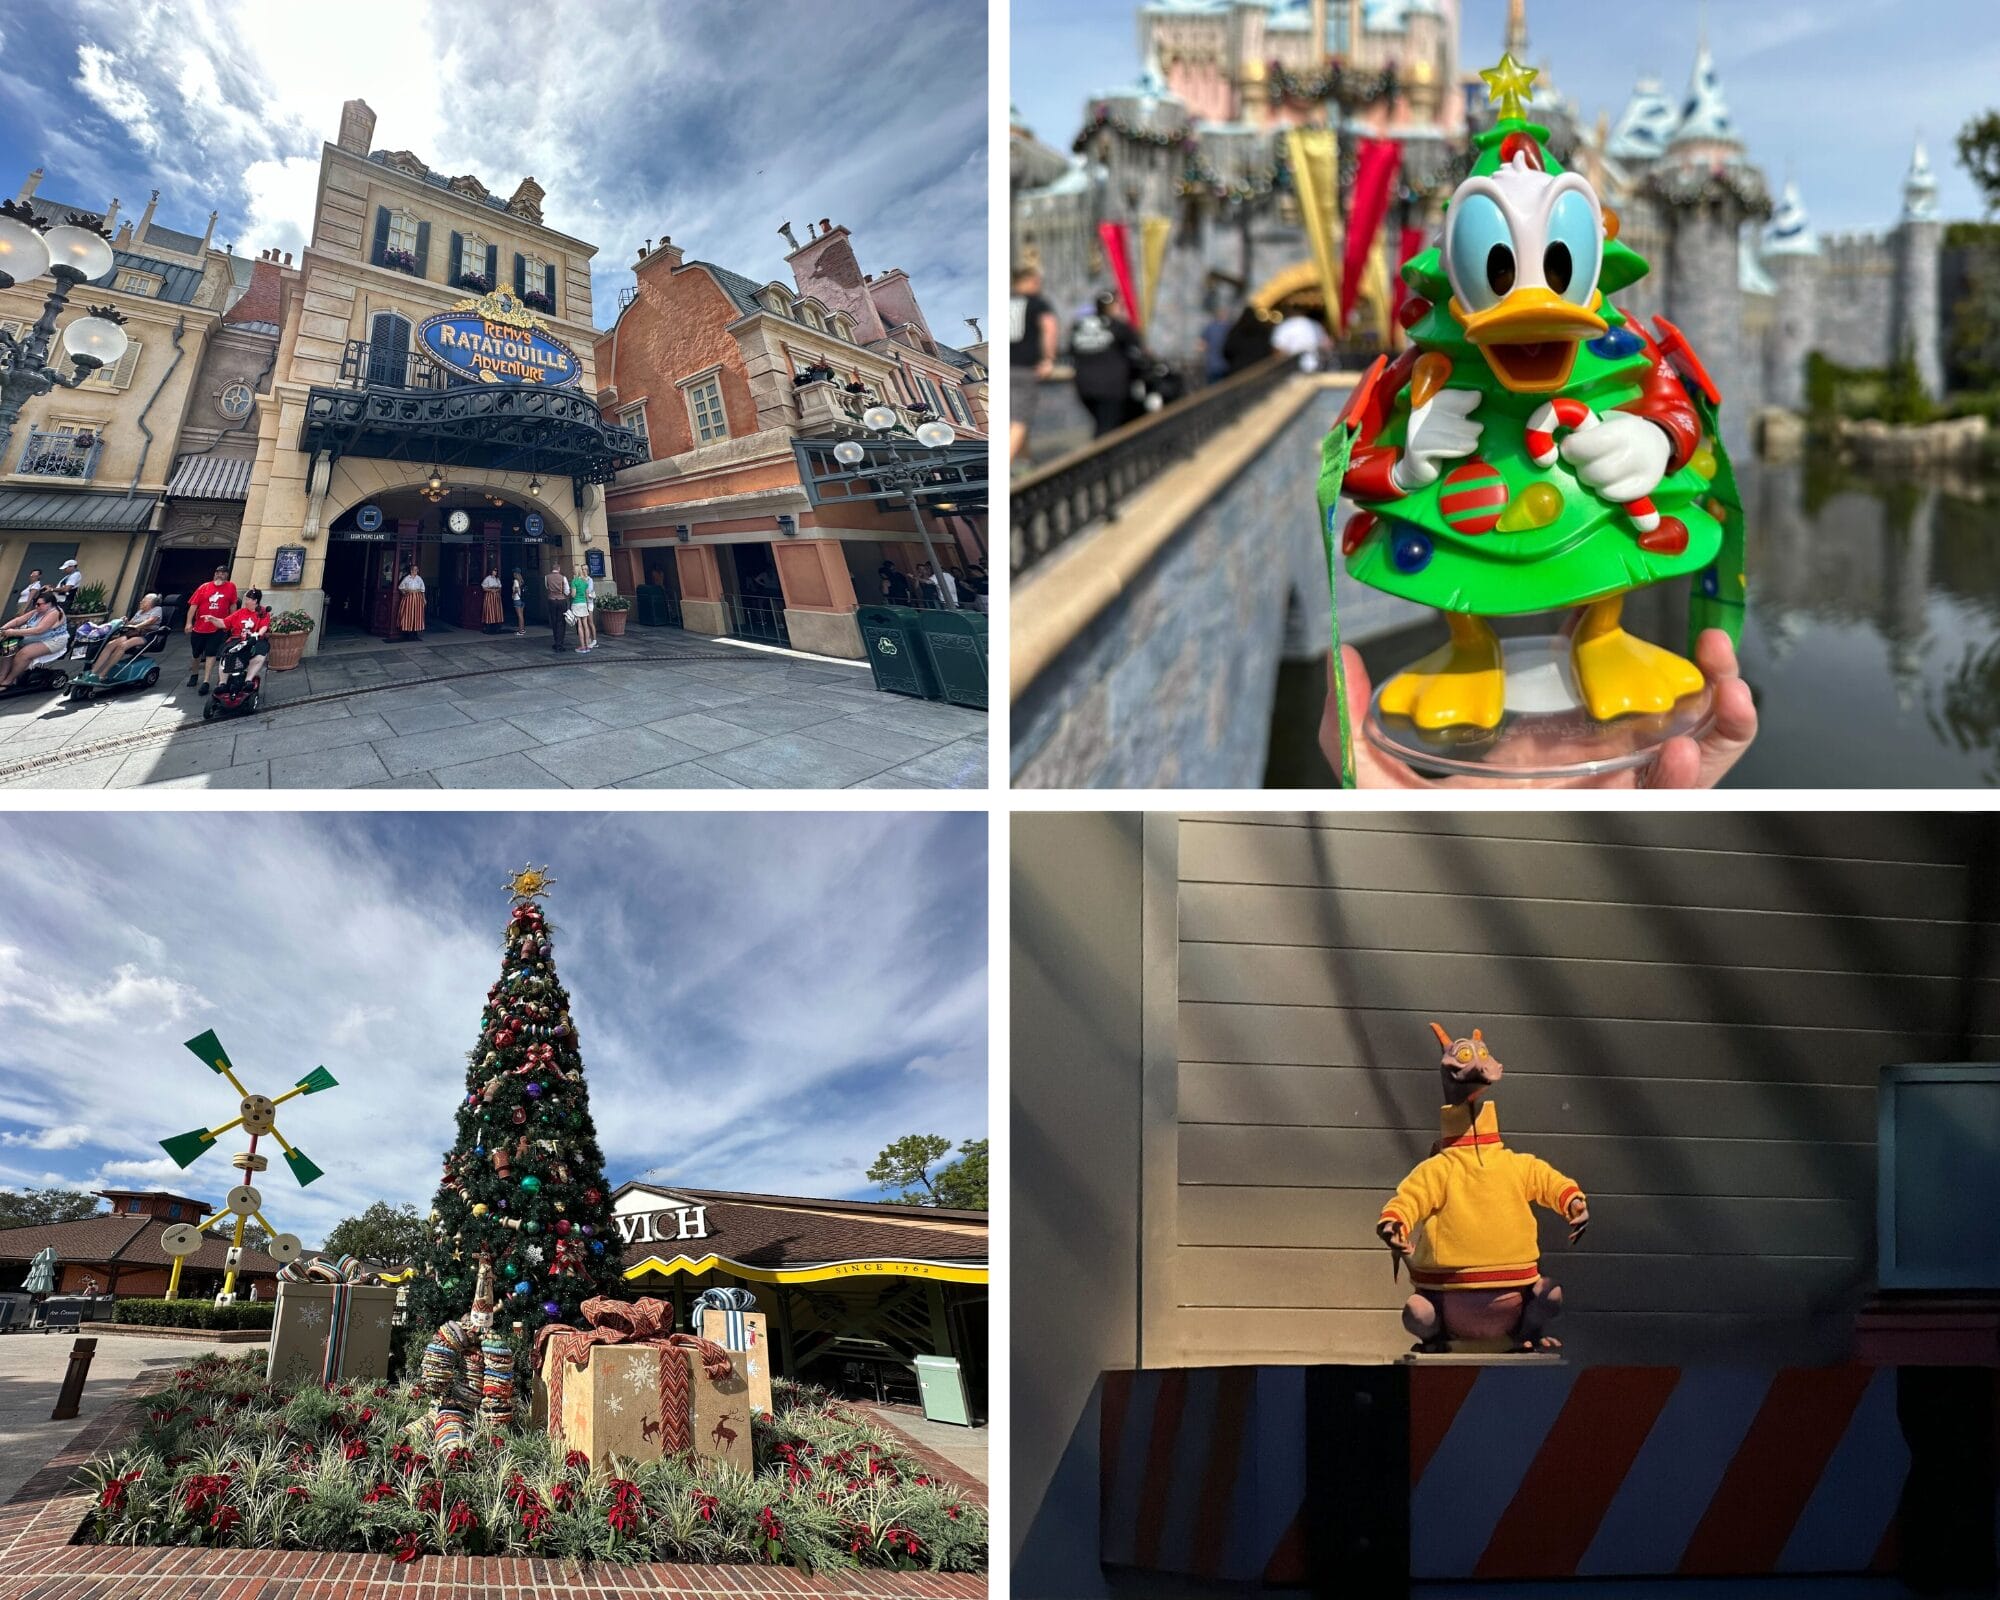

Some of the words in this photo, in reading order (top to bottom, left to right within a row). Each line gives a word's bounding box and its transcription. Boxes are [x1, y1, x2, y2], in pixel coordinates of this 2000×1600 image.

[440, 324, 568, 371] RATATOUILLE
[470, 353, 546, 382] ADVENTURE
[835, 1263, 883, 1275] SINCE
[895, 1264, 929, 1274] 1762
